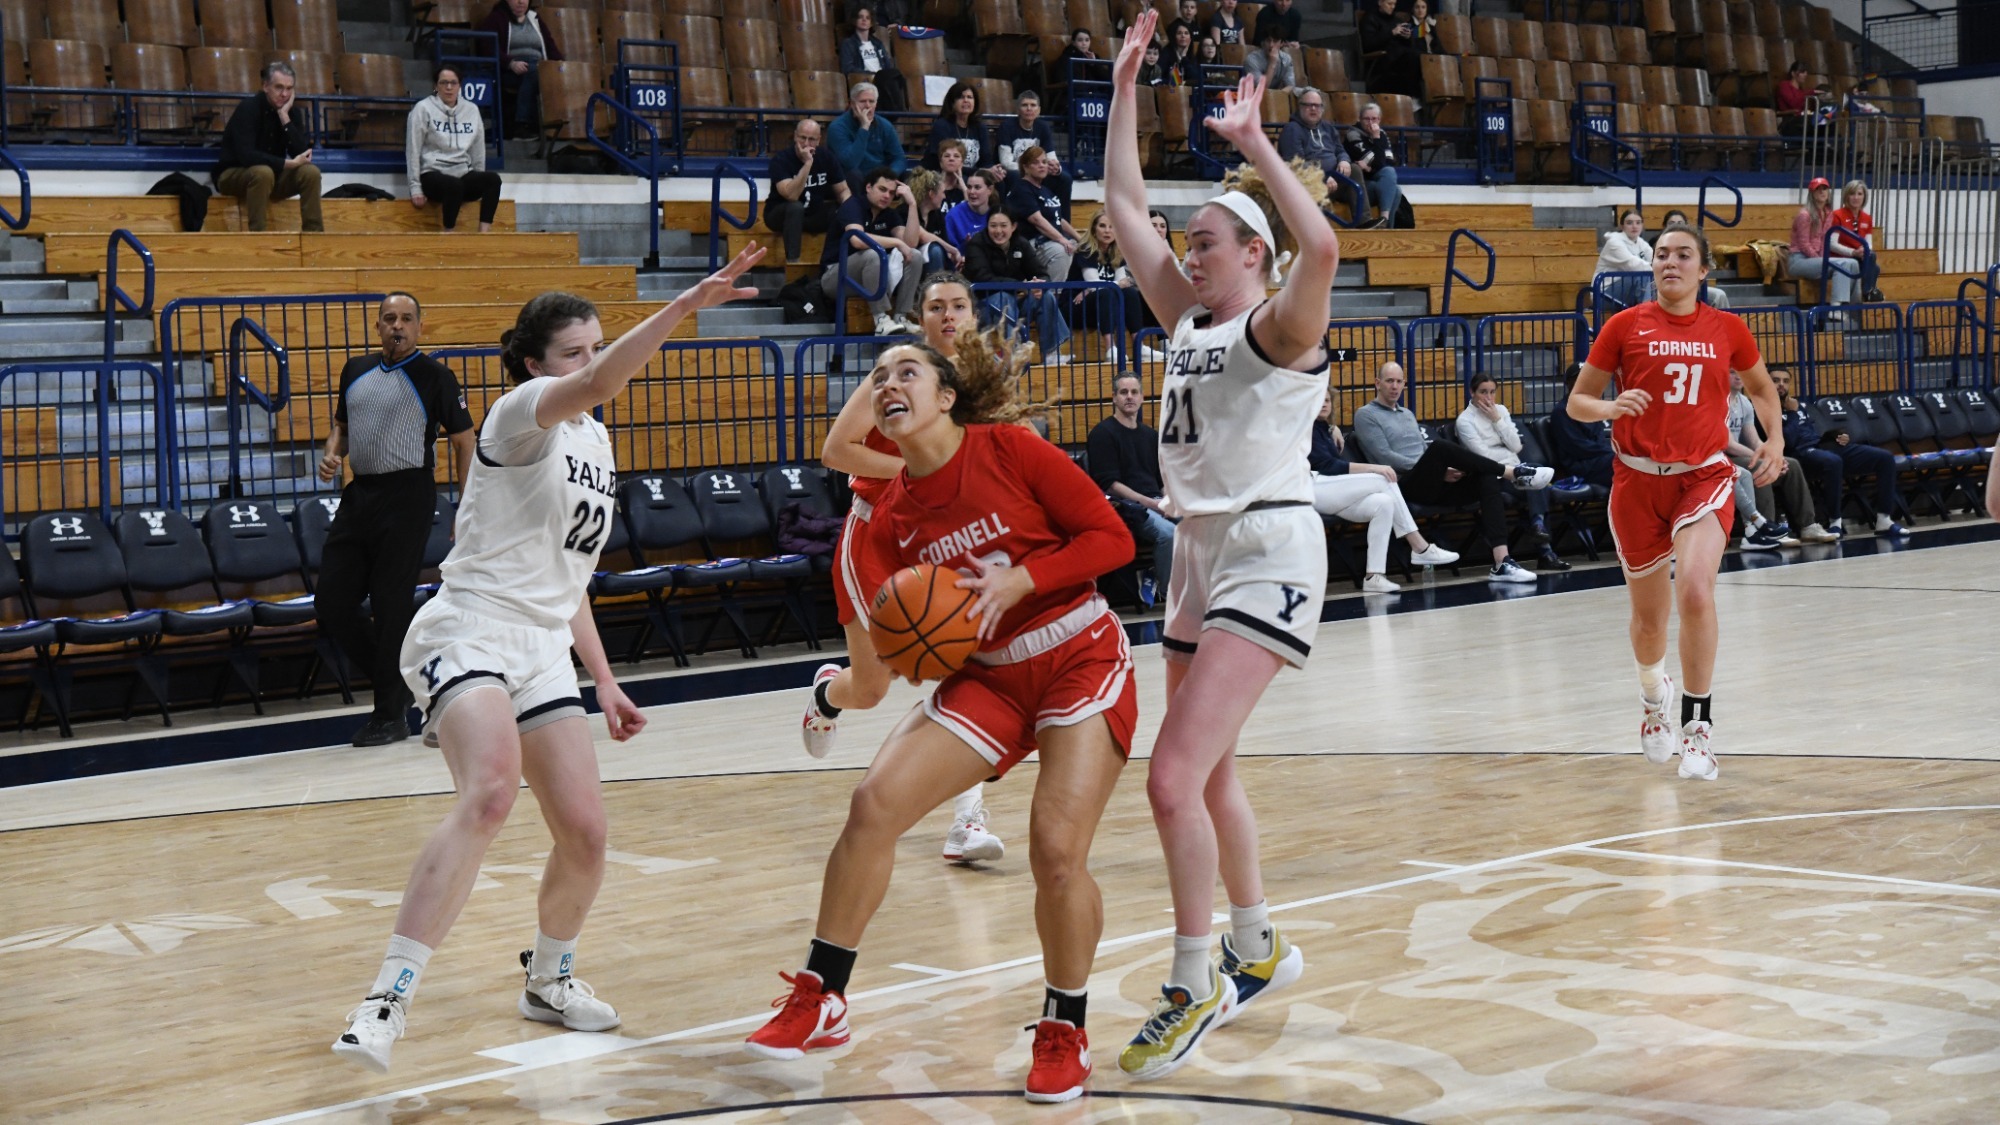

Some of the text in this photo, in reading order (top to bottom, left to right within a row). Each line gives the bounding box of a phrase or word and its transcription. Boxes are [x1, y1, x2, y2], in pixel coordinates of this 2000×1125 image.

[461, 82, 487, 101] 07
[636, 89, 667, 107] 108
[1081, 102, 1104, 118] 108
[1212, 106, 1226, 120] 10
[432, 119, 473, 134] YALE
[1486, 116, 1505, 131] 109
[1590, 119, 1609, 133] 110
[1337, 350, 1346, 361] Y
[1649, 340, 1717, 359] CORNELL
[1663, 362, 1703, 405] 31
[1161, 388, 1199, 444] 21
[565, 454, 618, 499] YALE
[563, 500, 606, 555] 22
[918, 512, 1011, 566] CORNELL
[1277, 583, 1309, 625] Y
[419, 654, 443, 692] Y
